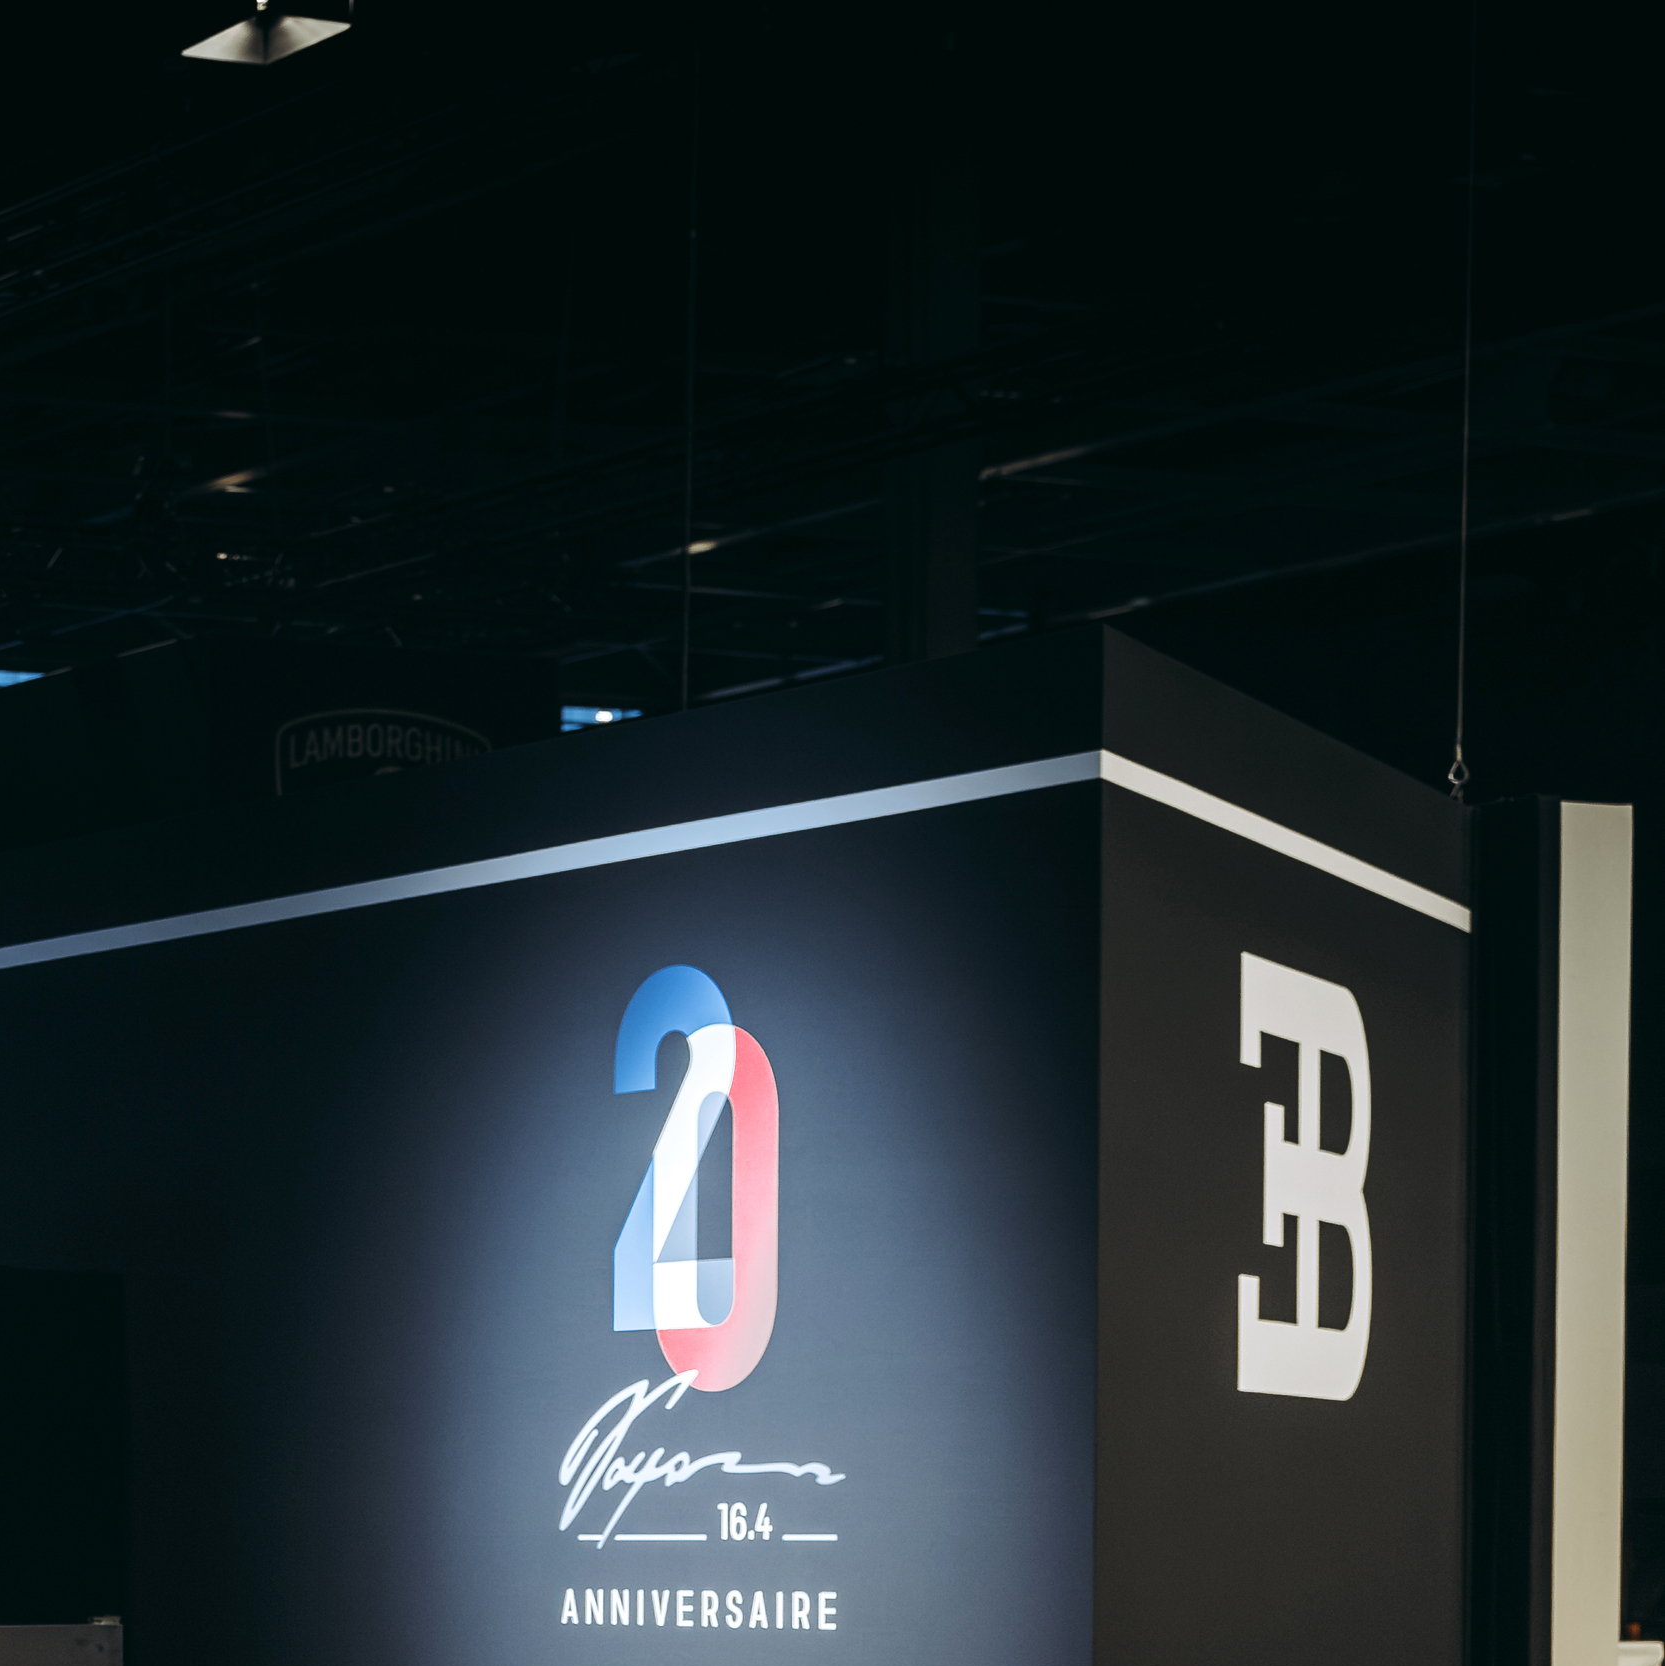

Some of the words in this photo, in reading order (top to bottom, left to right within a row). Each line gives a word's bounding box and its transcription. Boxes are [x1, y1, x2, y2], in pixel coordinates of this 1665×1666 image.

[614, 964, 779, 1392] 20
[716, 1502, 773, 1541] 16.4
[560, 1588, 838, 1630] ANNIVERSAIRE
